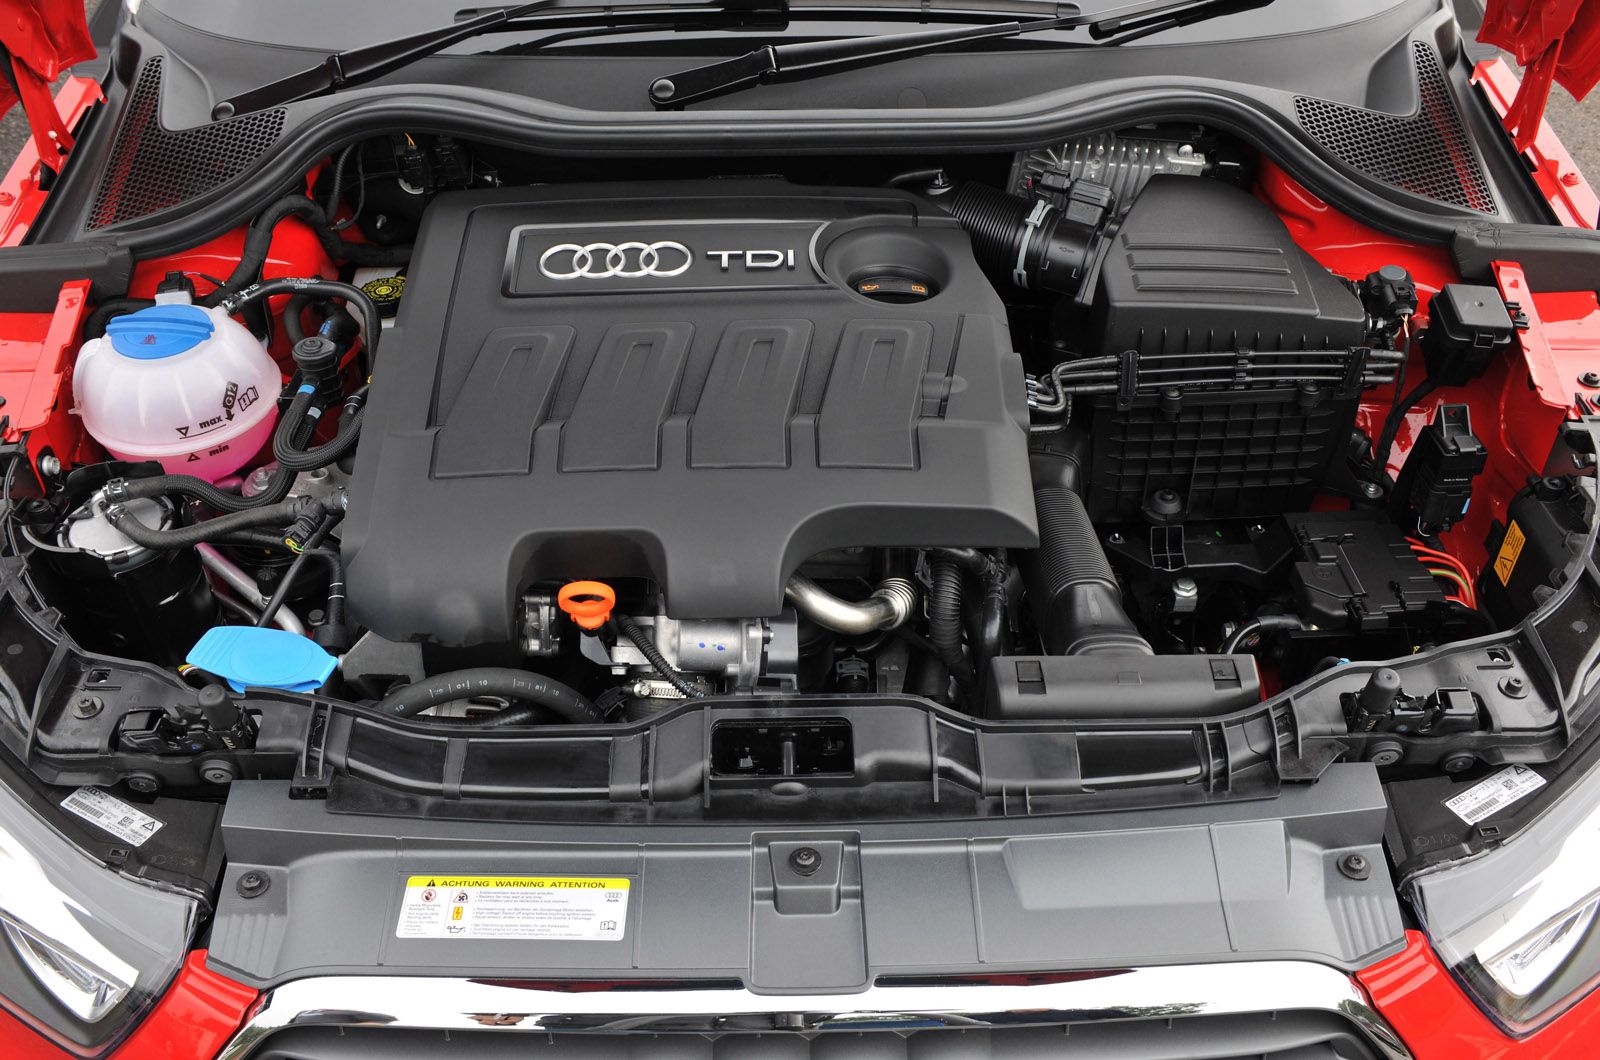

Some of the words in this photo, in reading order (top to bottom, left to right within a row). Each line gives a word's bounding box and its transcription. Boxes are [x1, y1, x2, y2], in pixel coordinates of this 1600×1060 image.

[706, 249, 795, 269] TDI
[224, 383, 237, 406] G12
[199, 415, 223, 429] max
[209, 444, 229, 456] min
[440, 880, 490, 888] ACHTUNG
[550, 881, 606, 889] ATTENTION
